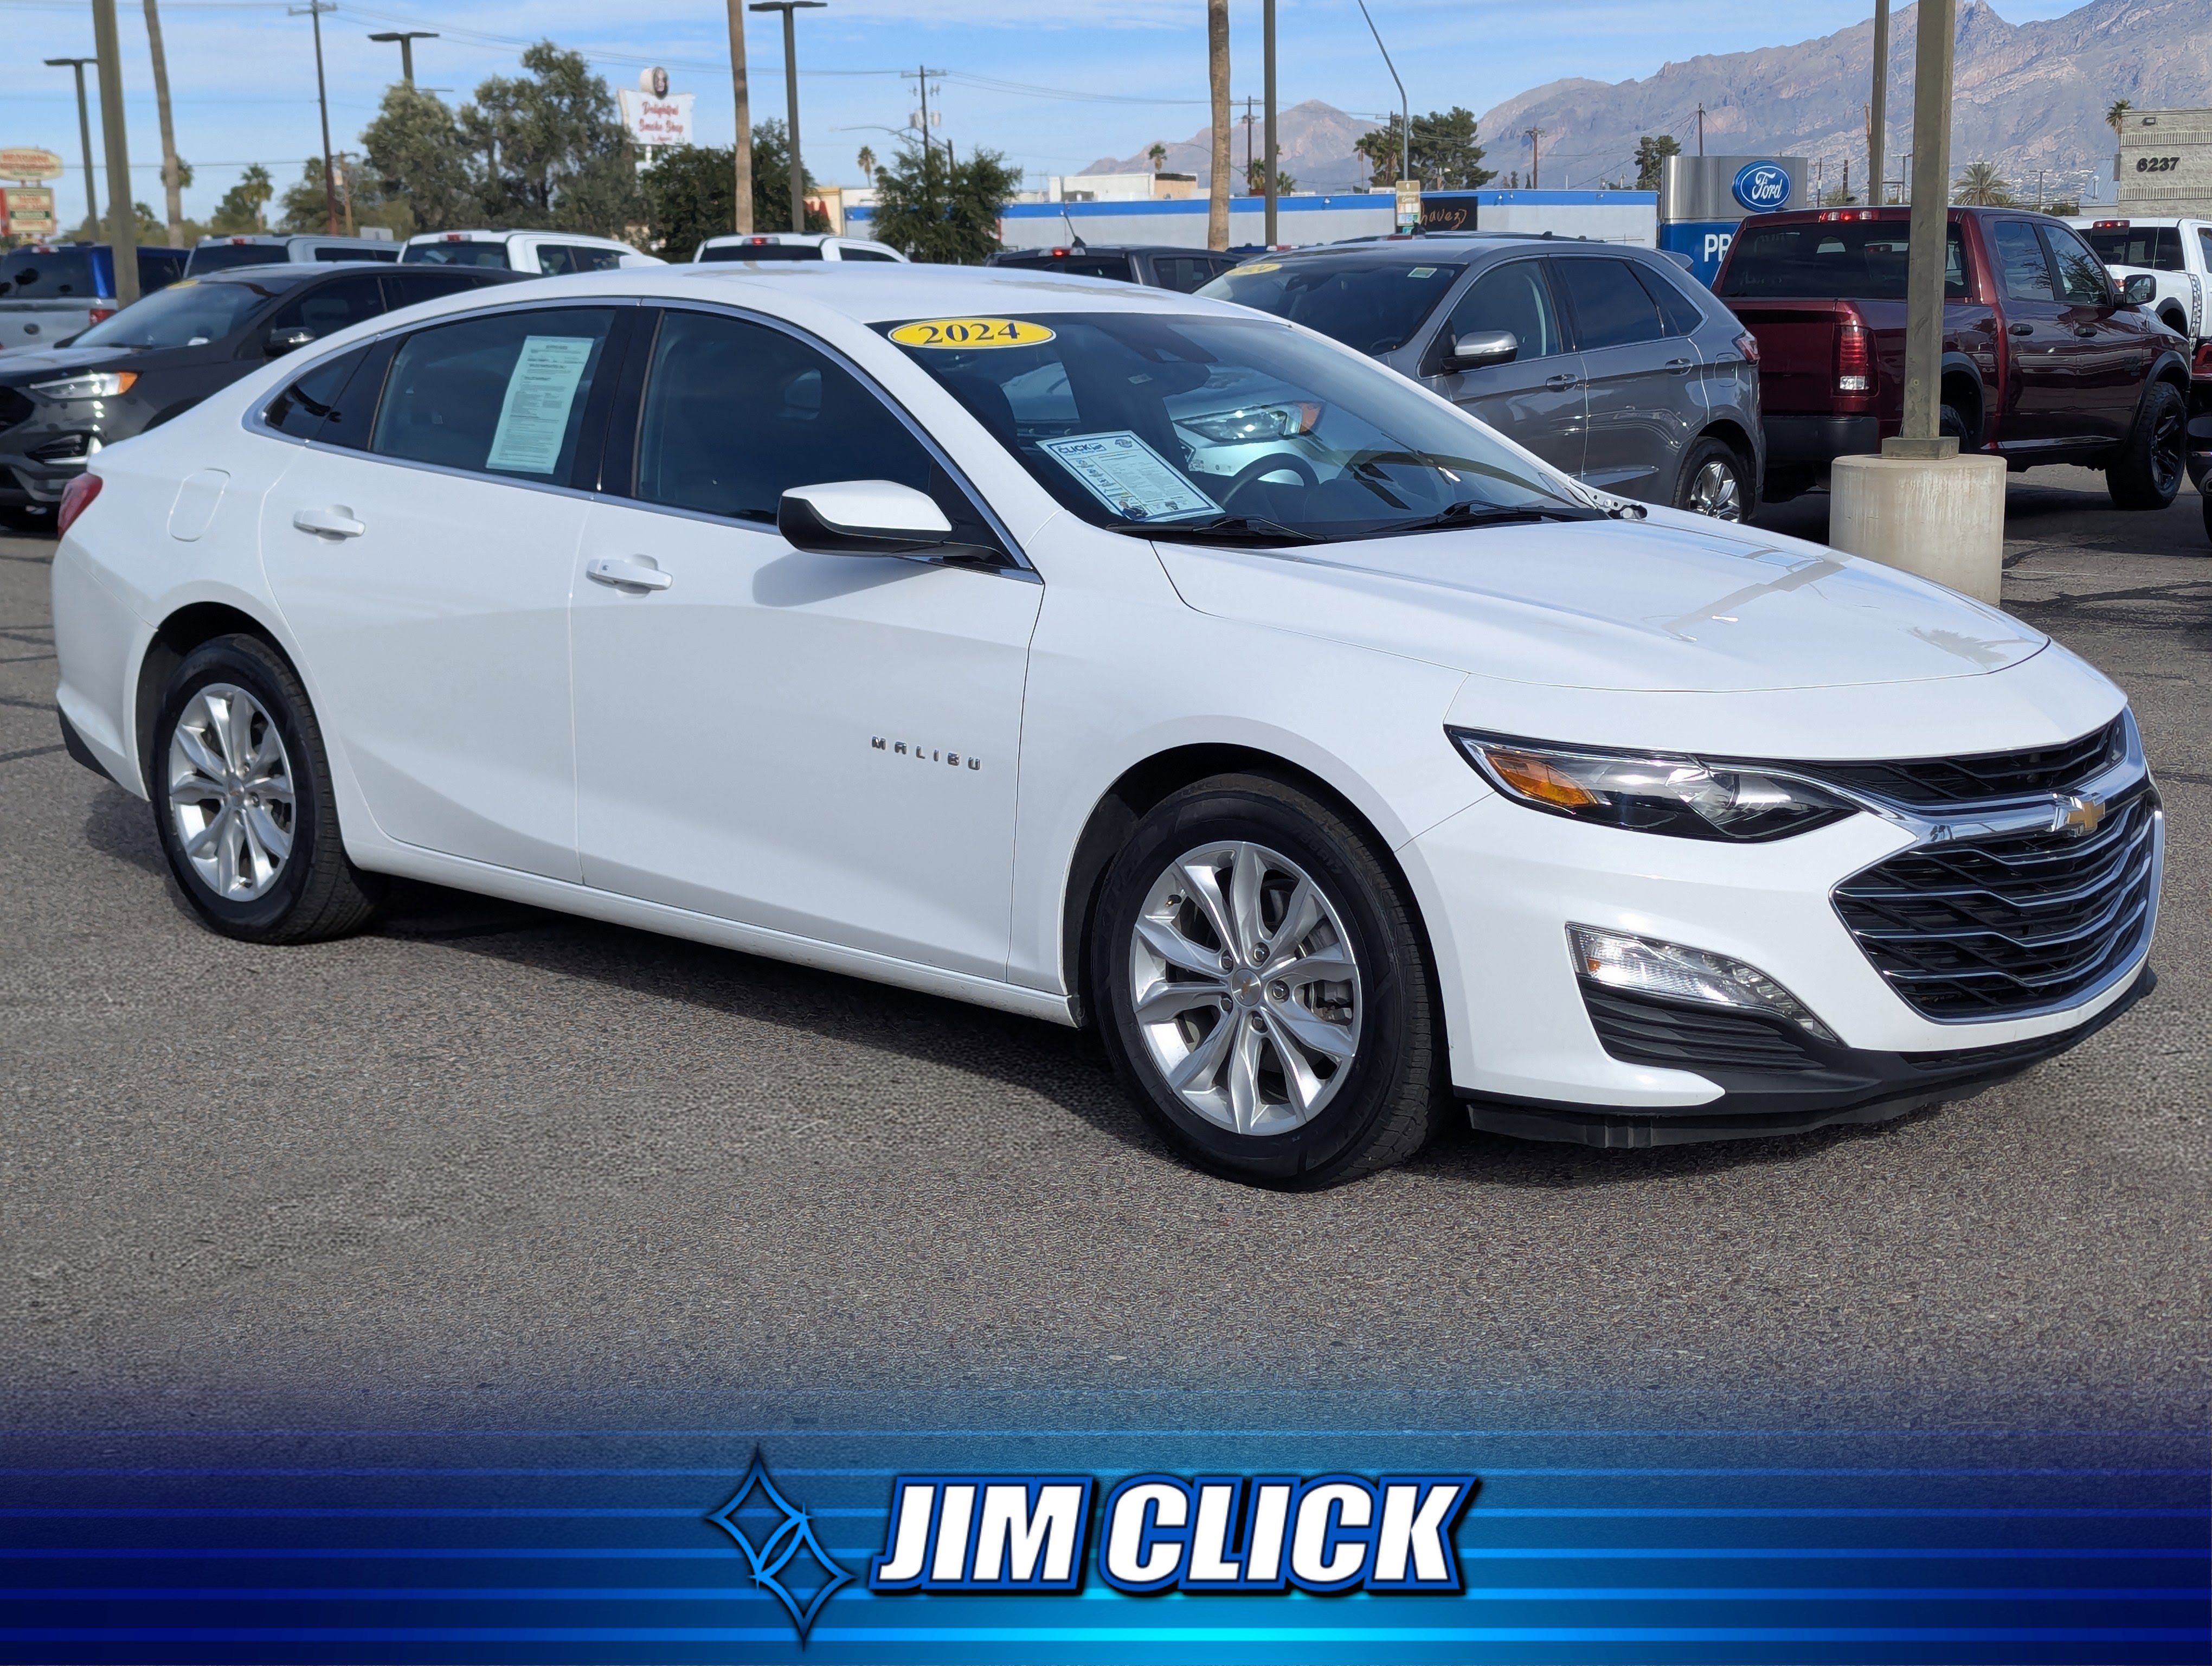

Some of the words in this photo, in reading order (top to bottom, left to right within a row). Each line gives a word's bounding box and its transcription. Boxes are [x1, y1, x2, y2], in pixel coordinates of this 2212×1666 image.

[639, 118, 663, 132] Smoke
[666, 120, 684, 136] Shop
[2136, 157, 2180, 172] 6237
[1751, 171, 1783, 200] Ford
[1420, 200, 1467, 230] havez
[1704, 233, 1736, 262] PR
[918, 323, 1020, 344] 2024
[1058, 444, 1091, 454] CLICK
[871, 736, 981, 771] MALIBU
